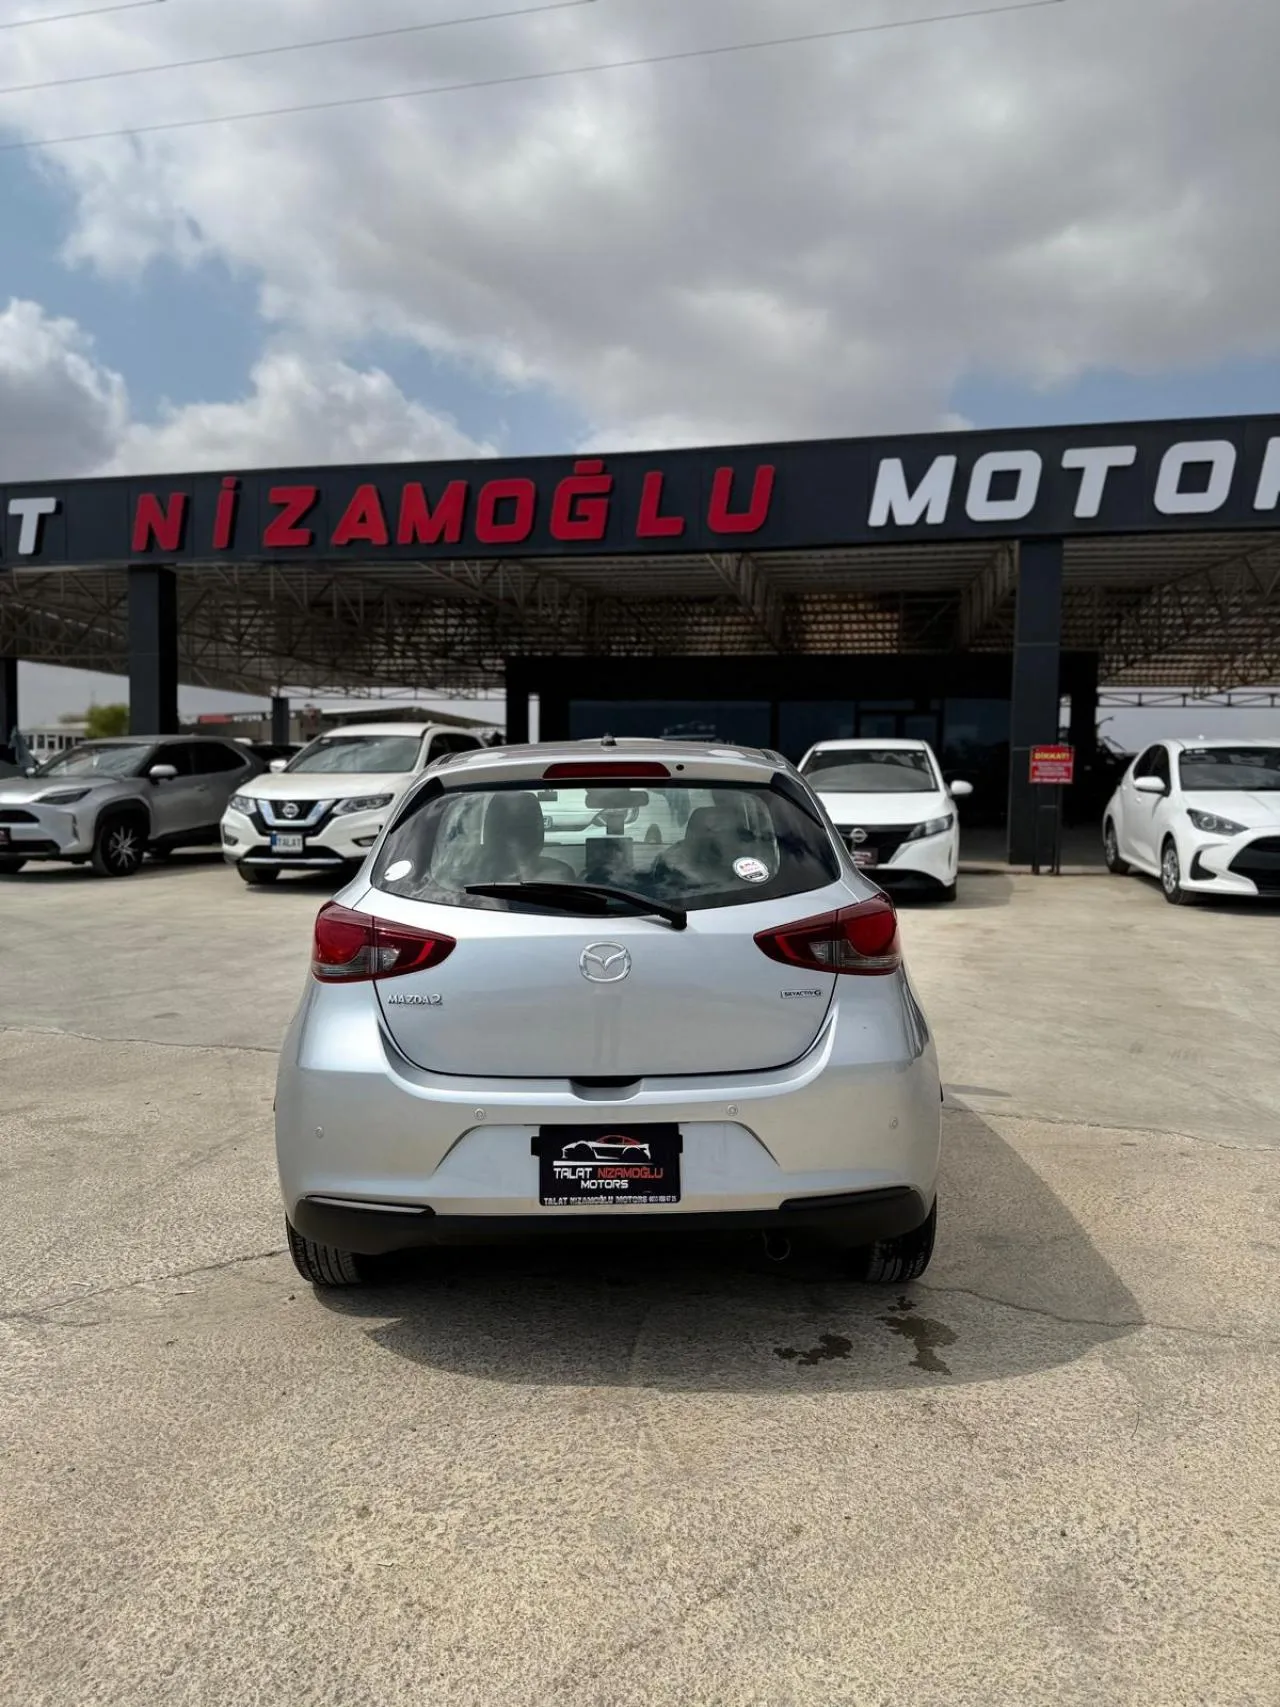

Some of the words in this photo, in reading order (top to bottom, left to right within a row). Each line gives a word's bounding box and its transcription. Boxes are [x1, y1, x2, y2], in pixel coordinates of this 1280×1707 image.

[131, 459, 776, 553] NİZAMOĞLU
[553, 1167, 593, 1180] TALAT
[580, 1179, 629, 1189] MOTORS
[543, 1197, 568, 1206] TALAT
[615, 1196, 647, 1204] MOTORS
